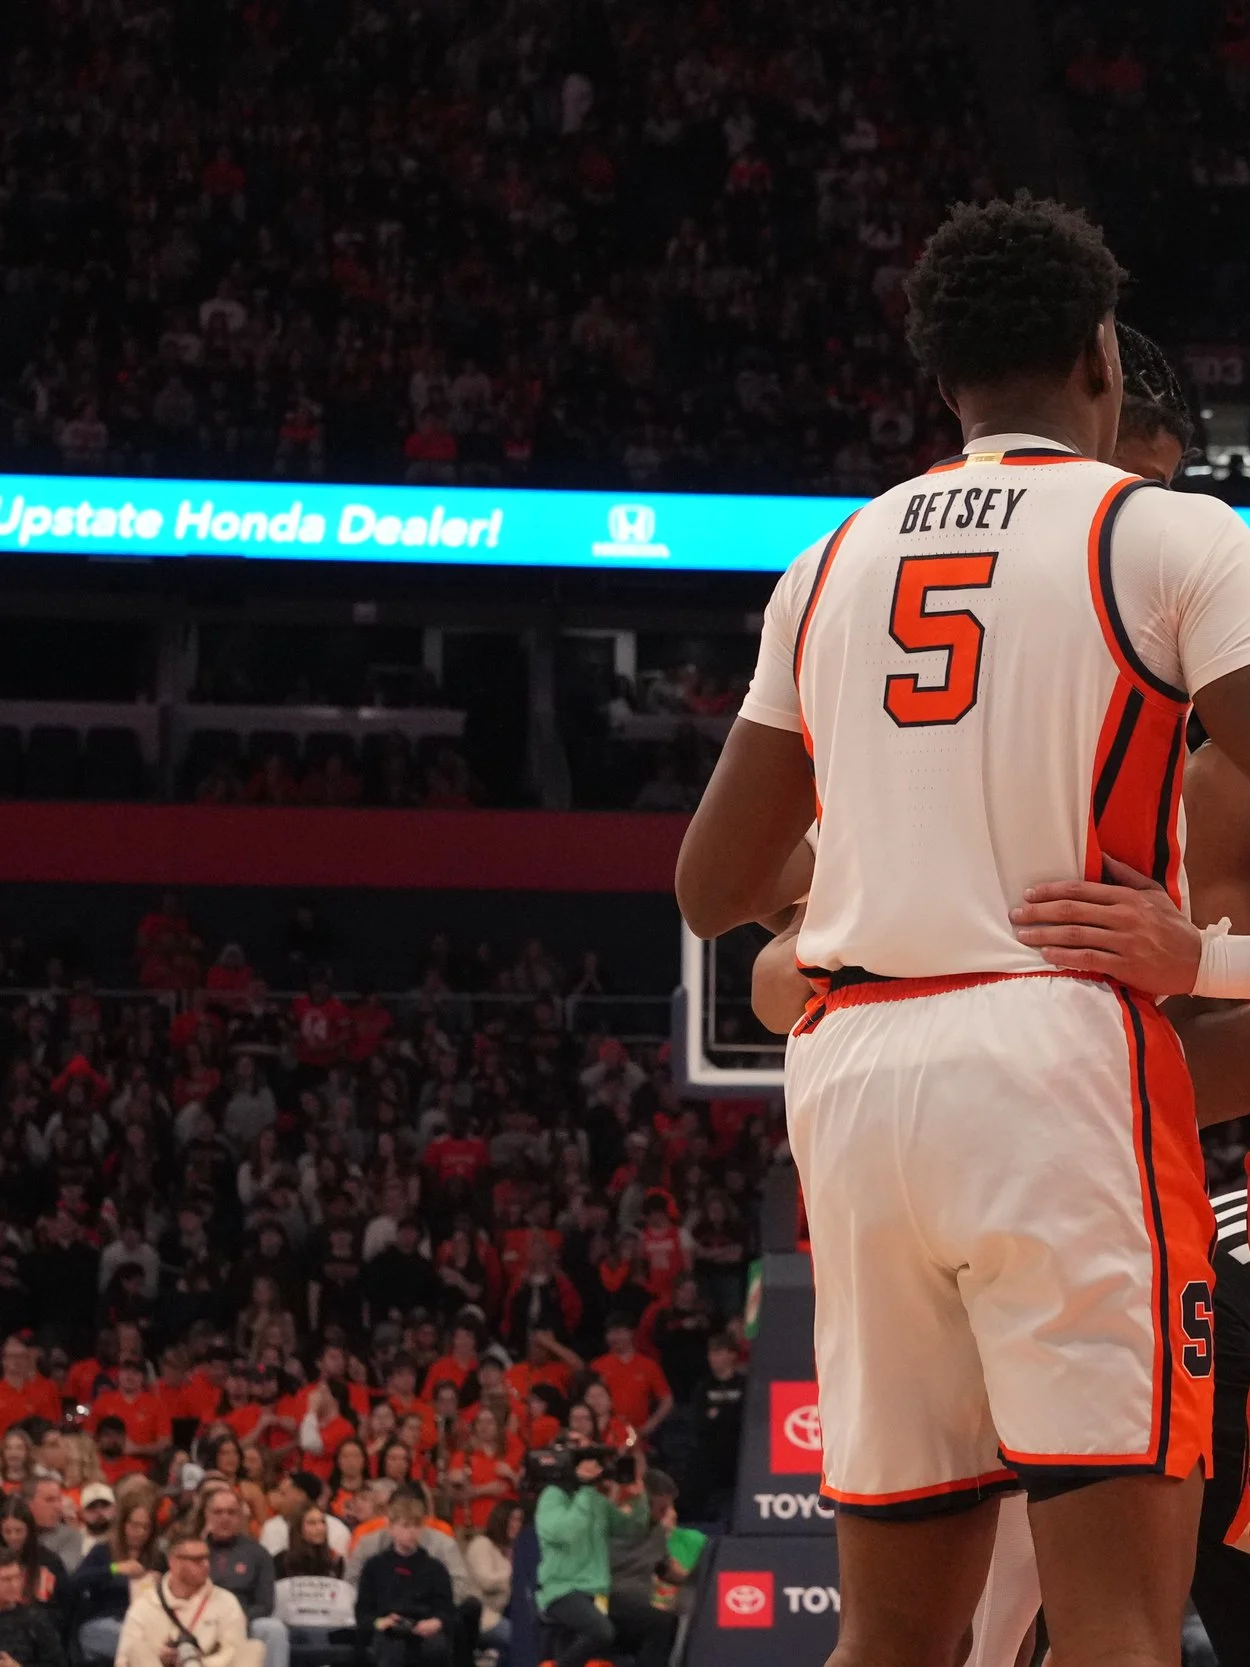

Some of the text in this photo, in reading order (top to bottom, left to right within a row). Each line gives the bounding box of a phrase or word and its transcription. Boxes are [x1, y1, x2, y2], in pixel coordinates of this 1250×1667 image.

[0, 495, 504, 549] Upstate Honda Dealer!
[900, 487, 1027, 534] BETSEY
[883, 552, 999, 728] 5
